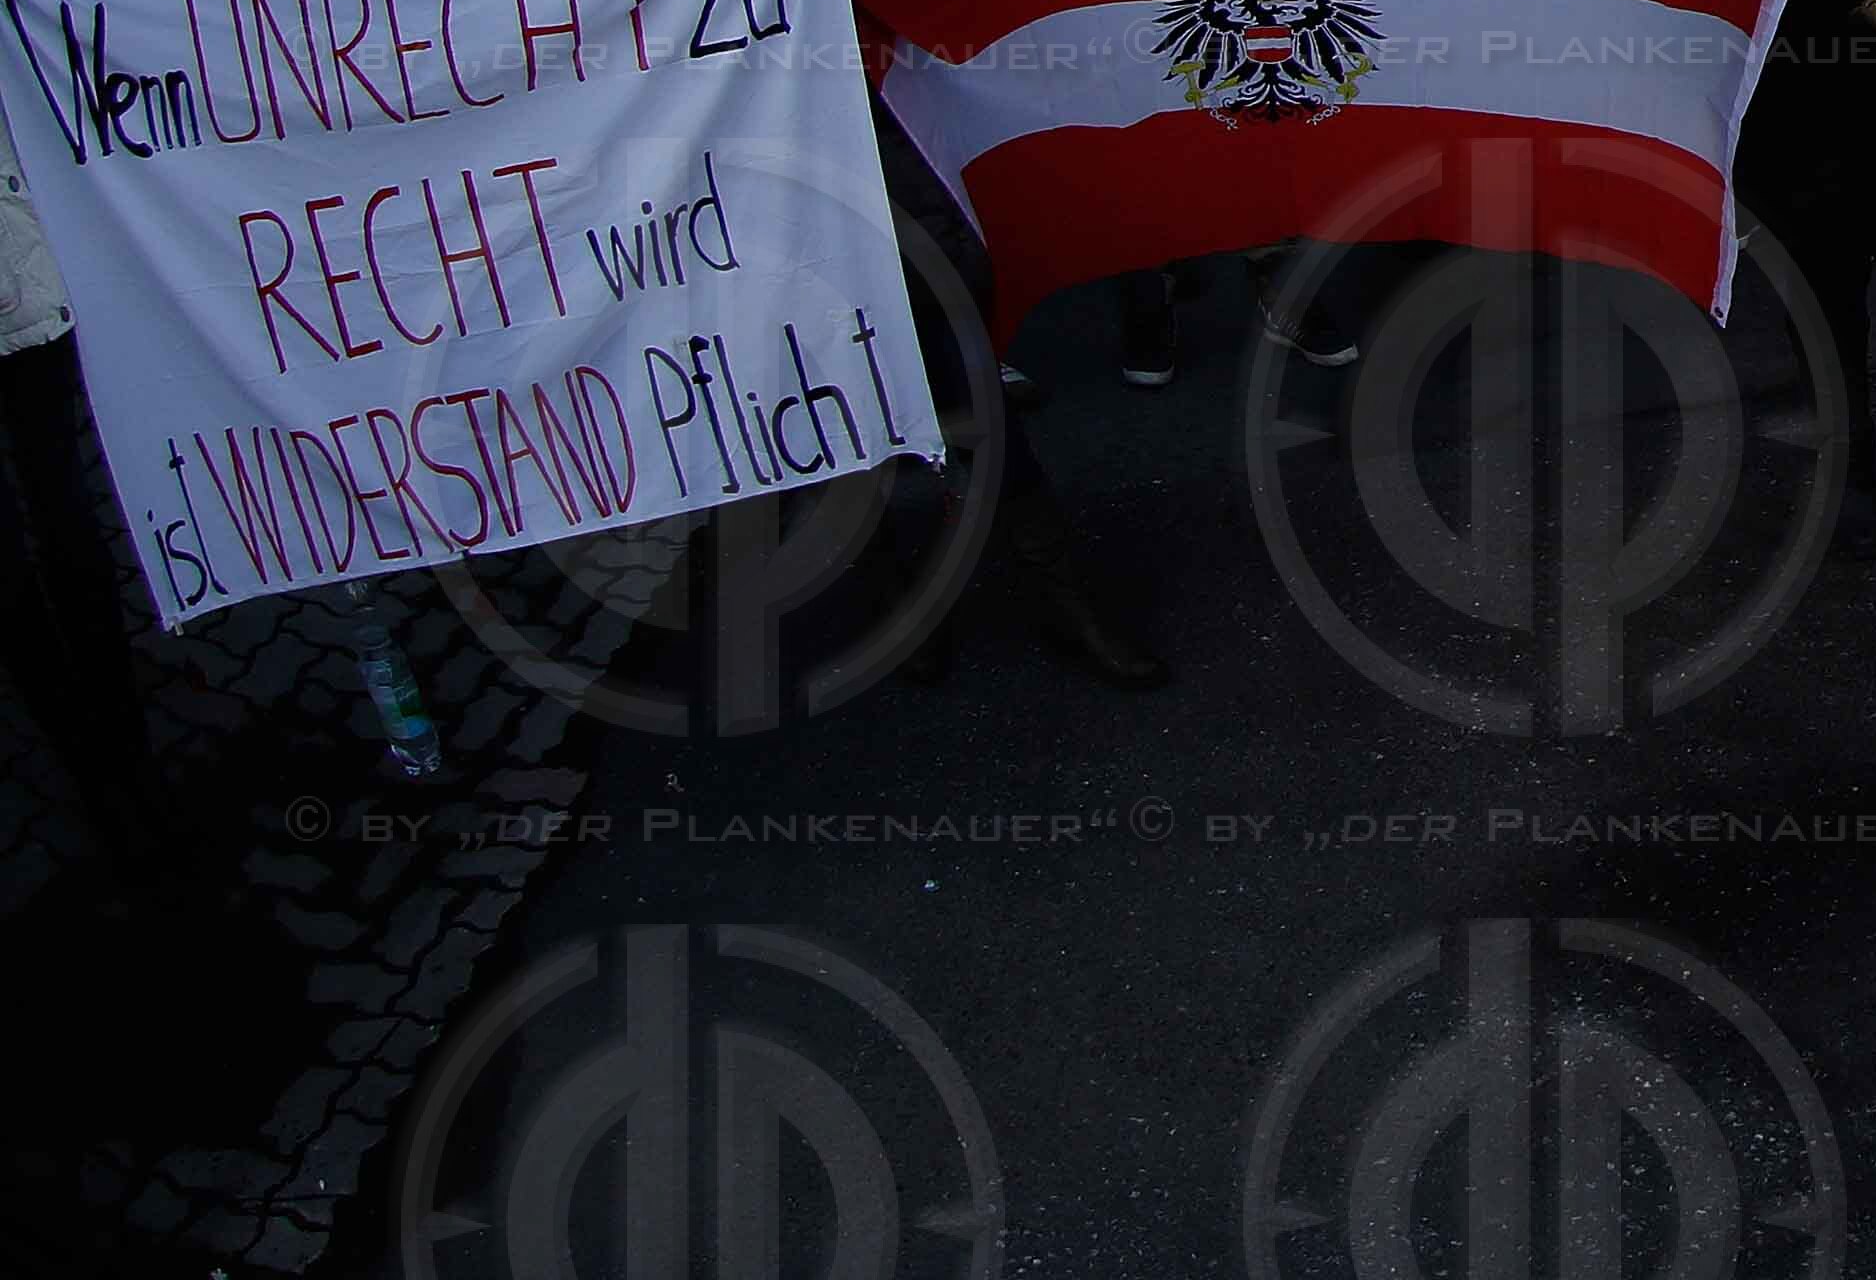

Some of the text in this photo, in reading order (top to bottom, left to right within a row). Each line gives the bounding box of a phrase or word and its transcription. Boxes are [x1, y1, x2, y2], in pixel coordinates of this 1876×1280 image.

[240, 152, 740, 375] RECHT wird
[152, 307, 906, 610] ist WIDERSTAND Pflicht
